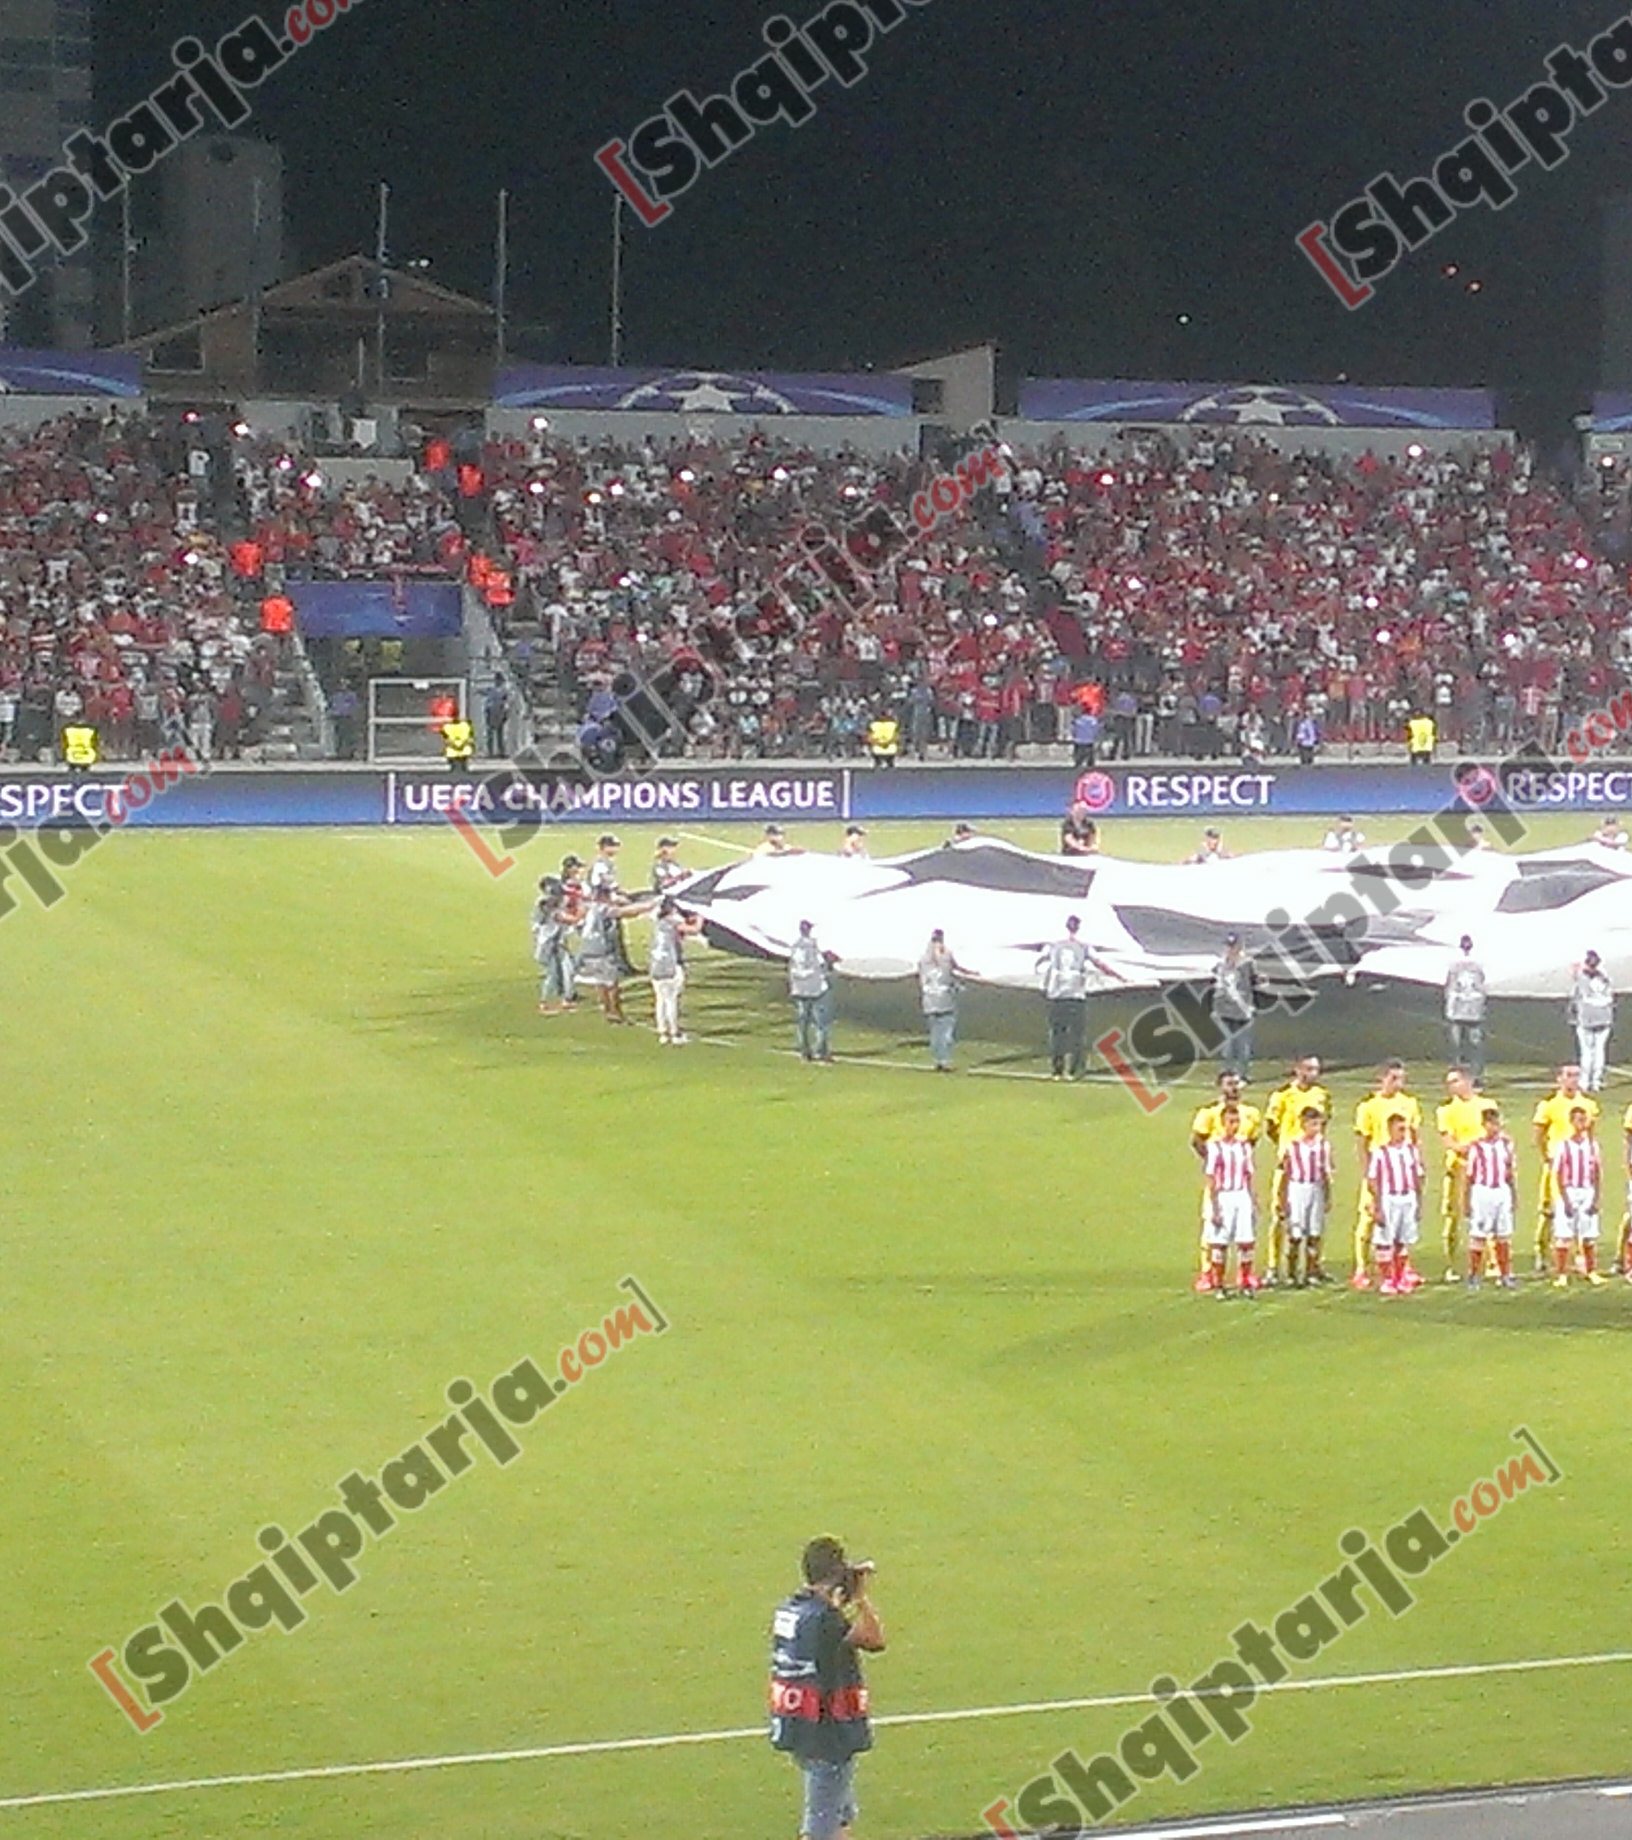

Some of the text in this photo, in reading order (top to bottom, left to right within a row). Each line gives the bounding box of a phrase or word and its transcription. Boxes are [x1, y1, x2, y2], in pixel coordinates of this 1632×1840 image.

[404, 780, 835, 812] UEFA CHAMPIONS LEAGUE
[1126, 774, 1276, 807] RESPECT
